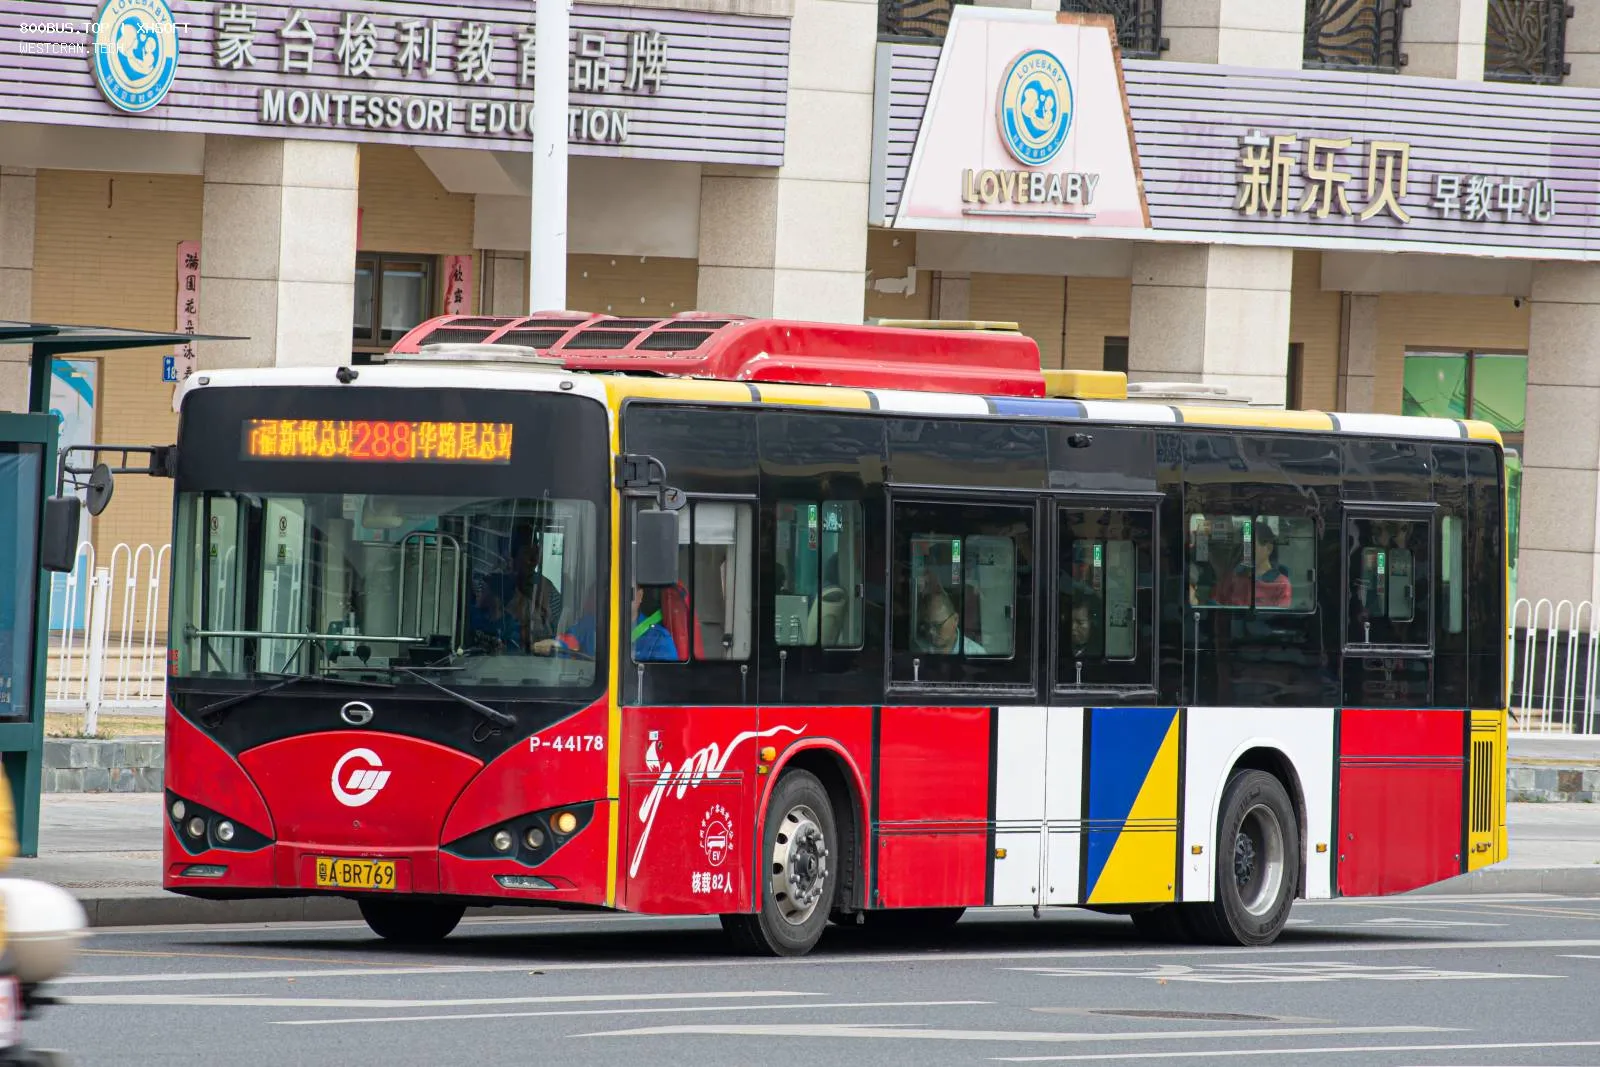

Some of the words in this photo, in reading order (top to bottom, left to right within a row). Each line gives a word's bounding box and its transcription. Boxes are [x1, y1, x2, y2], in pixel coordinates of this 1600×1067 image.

[1015, 59, 1063, 82] LOVEBABY
[261, 88, 452, 132] MONTESSORI
[468, 101, 630, 142] EDUTION
[963, 168, 1100, 205] LOVEBABY
[1237, 130, 1411, 224] 新乐贝
[1433, 175, 1556, 223] 早教中心
[353, 421, 410, 458] 288
[530, 736, 603, 752] P-44178
[712, 851, 721, 861] EV
